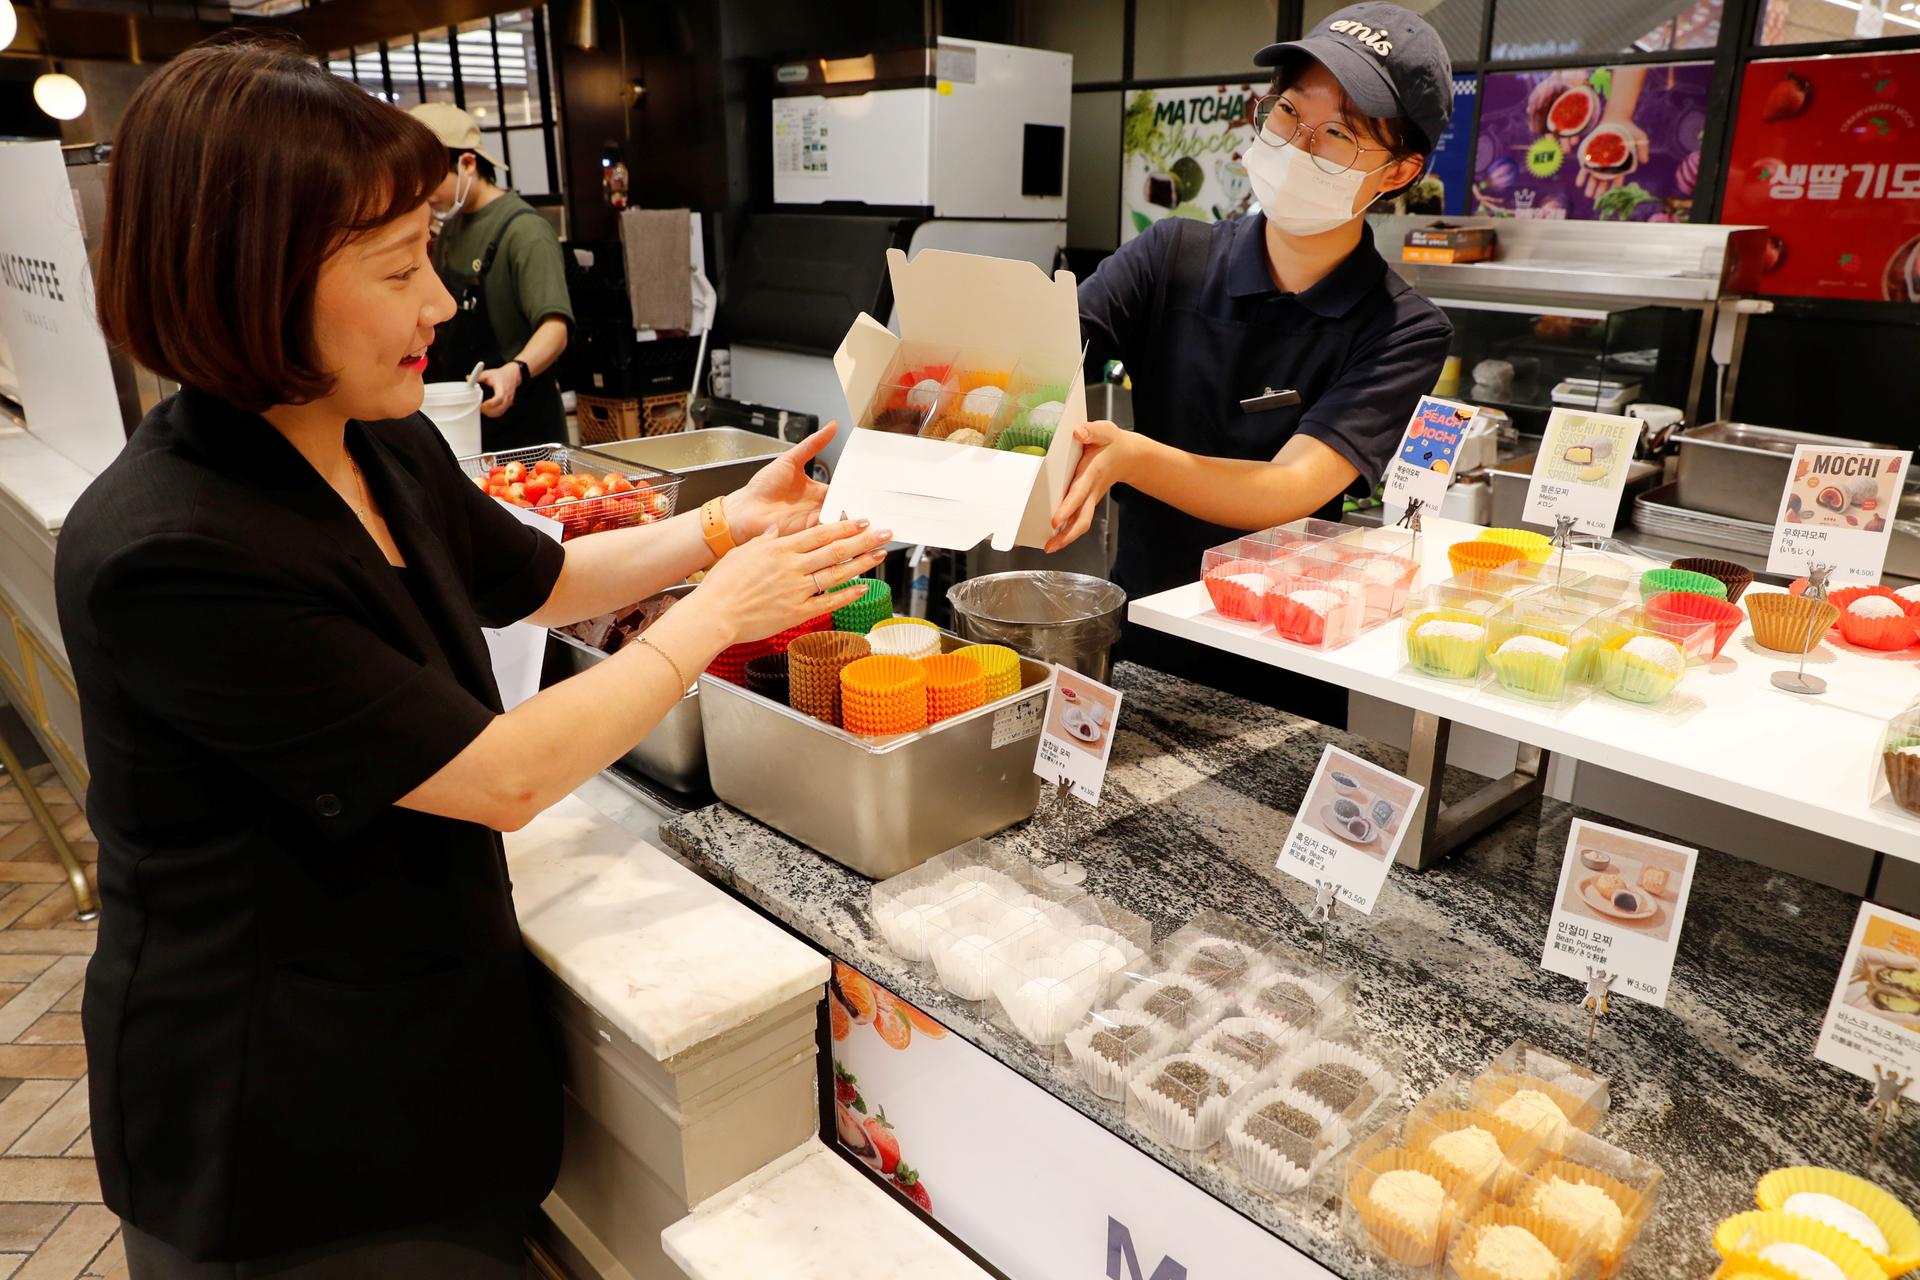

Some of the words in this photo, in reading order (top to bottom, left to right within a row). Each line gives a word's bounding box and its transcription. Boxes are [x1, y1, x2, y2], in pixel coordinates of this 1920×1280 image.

[1330, 20, 1393, 57] emis
[1154, 94, 1245, 127] MATCHA
[1533, 150, 1555, 164] NEW
[1422, 409, 1465, 428] PEACH
[1600, 423, 1626, 439] TREE
[1812, 454, 1880, 478] MOCHI
[1394, 472, 1409, 482] Peach
[1539, 493, 1558, 502] Melon
[1781, 537, 1794, 548] Fig
[1783, 528, 1828, 541] 무화과모찌
[1849, 568, 1875, 577] ₩4,500
[1291, 841, 1309, 855] Black
[1309, 850, 1325, 862] Bean
[1296, 831, 1320, 850] 흑임자
[1321, 844, 1337, 860] 모찌
[1342, 888, 1367, 906] ₩3,500
[1555, 933, 1574, 946] Bean
[1576, 940, 1606, 954] Powder
[1557, 920, 1590, 938] 인절미
[1591, 931, 1614, 948] 모찌
[1626, 976, 1658, 995] ₩3,500
[1837, 1011, 1870, 1031] 바스크
[1853, 1030, 1883, 1048] Cheese
[1883, 1042, 1905, 1057] Cake
